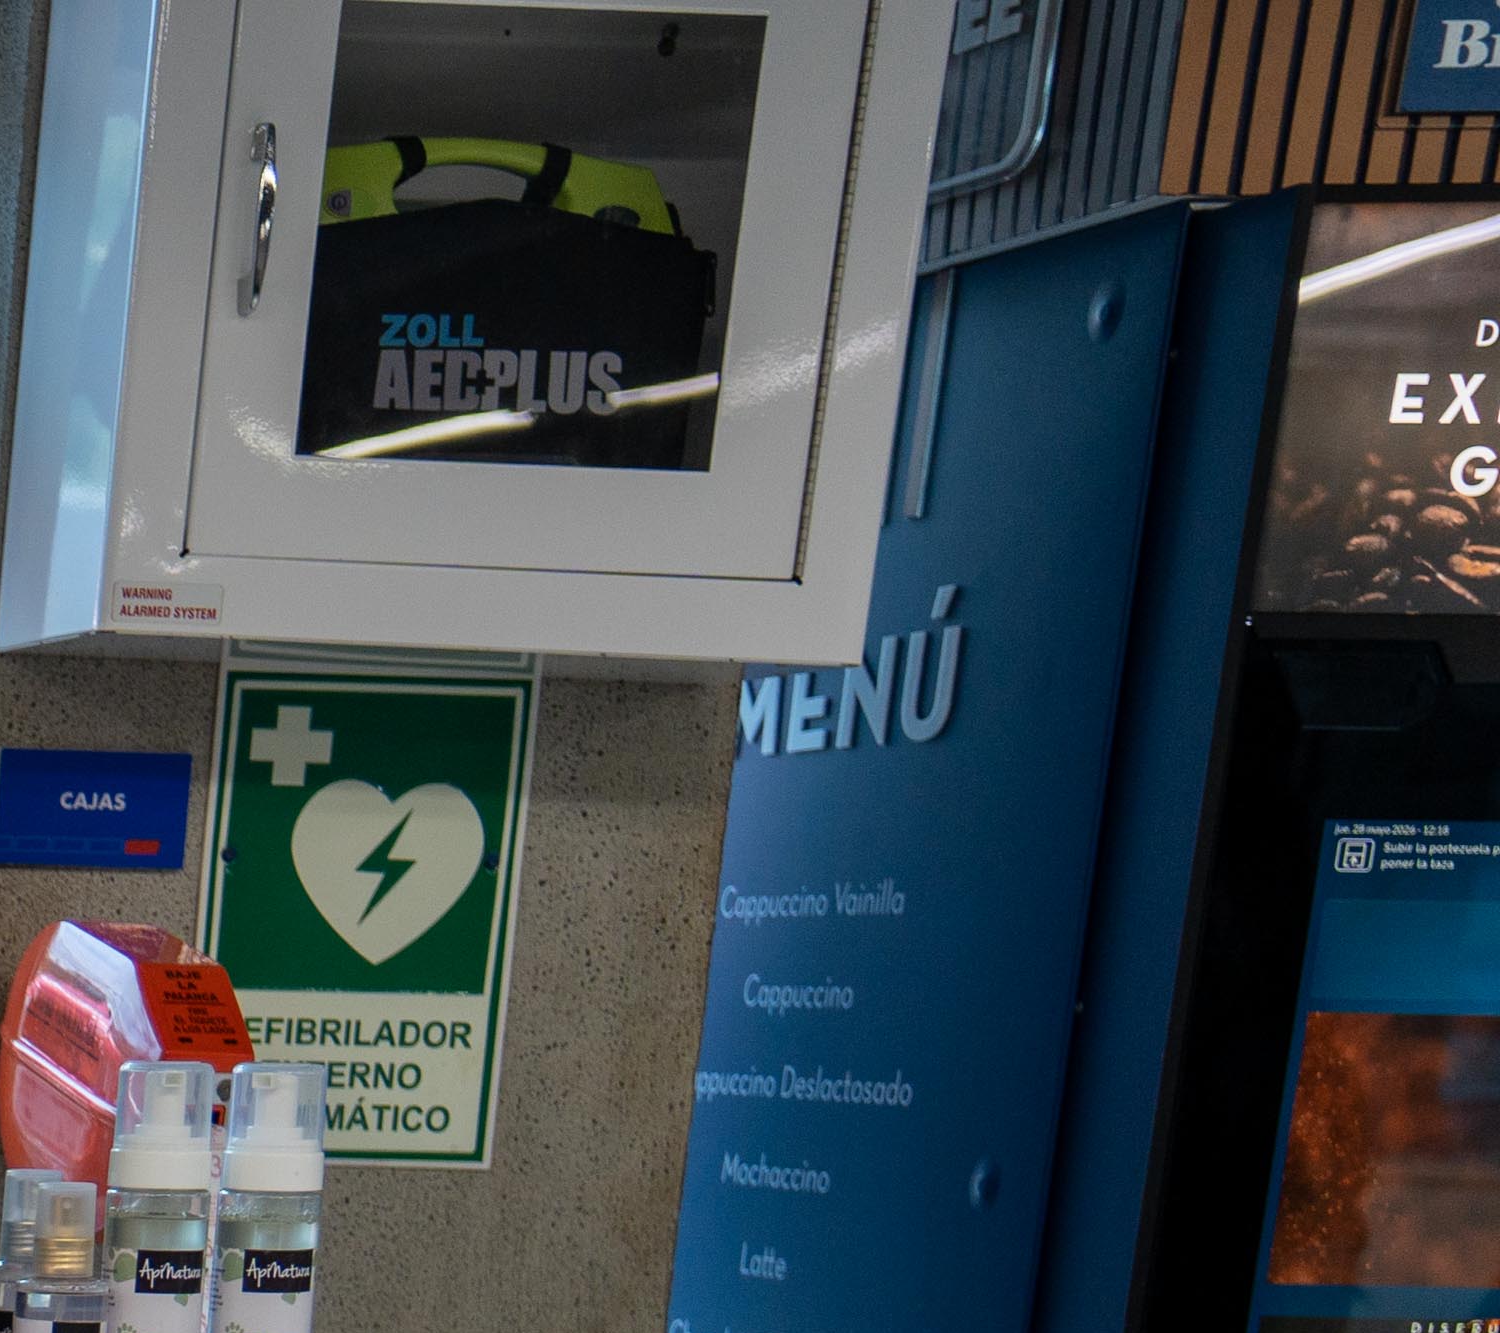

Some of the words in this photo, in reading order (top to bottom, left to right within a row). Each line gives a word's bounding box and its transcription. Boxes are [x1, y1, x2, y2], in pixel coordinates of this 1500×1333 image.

[378, 314, 484, 347] ZOLL
[122, 587, 172, 600] WARNING
[120, 604, 171, 619] ALARMED
[174, 606, 217, 620] SYSTEM
[736, 583, 964, 757] MENÚ
[60, 791, 127, 812] CAJAS
[719, 885, 828, 926] Cappuccino
[834, 878, 906, 917] Vainilla
[743, 974, 855, 1017] Cappuccino
[246, 1017, 472, 1049] EFIBRILADOR
[695, 1068, 776, 1101] ppuccino
[780, 1065, 914, 1107] Deslactosado
[324, 1097, 451, 1132] MÁTICO
[721, 1152, 831, 1195] Mochaccino
[740, 1243, 788, 1281] Latte
